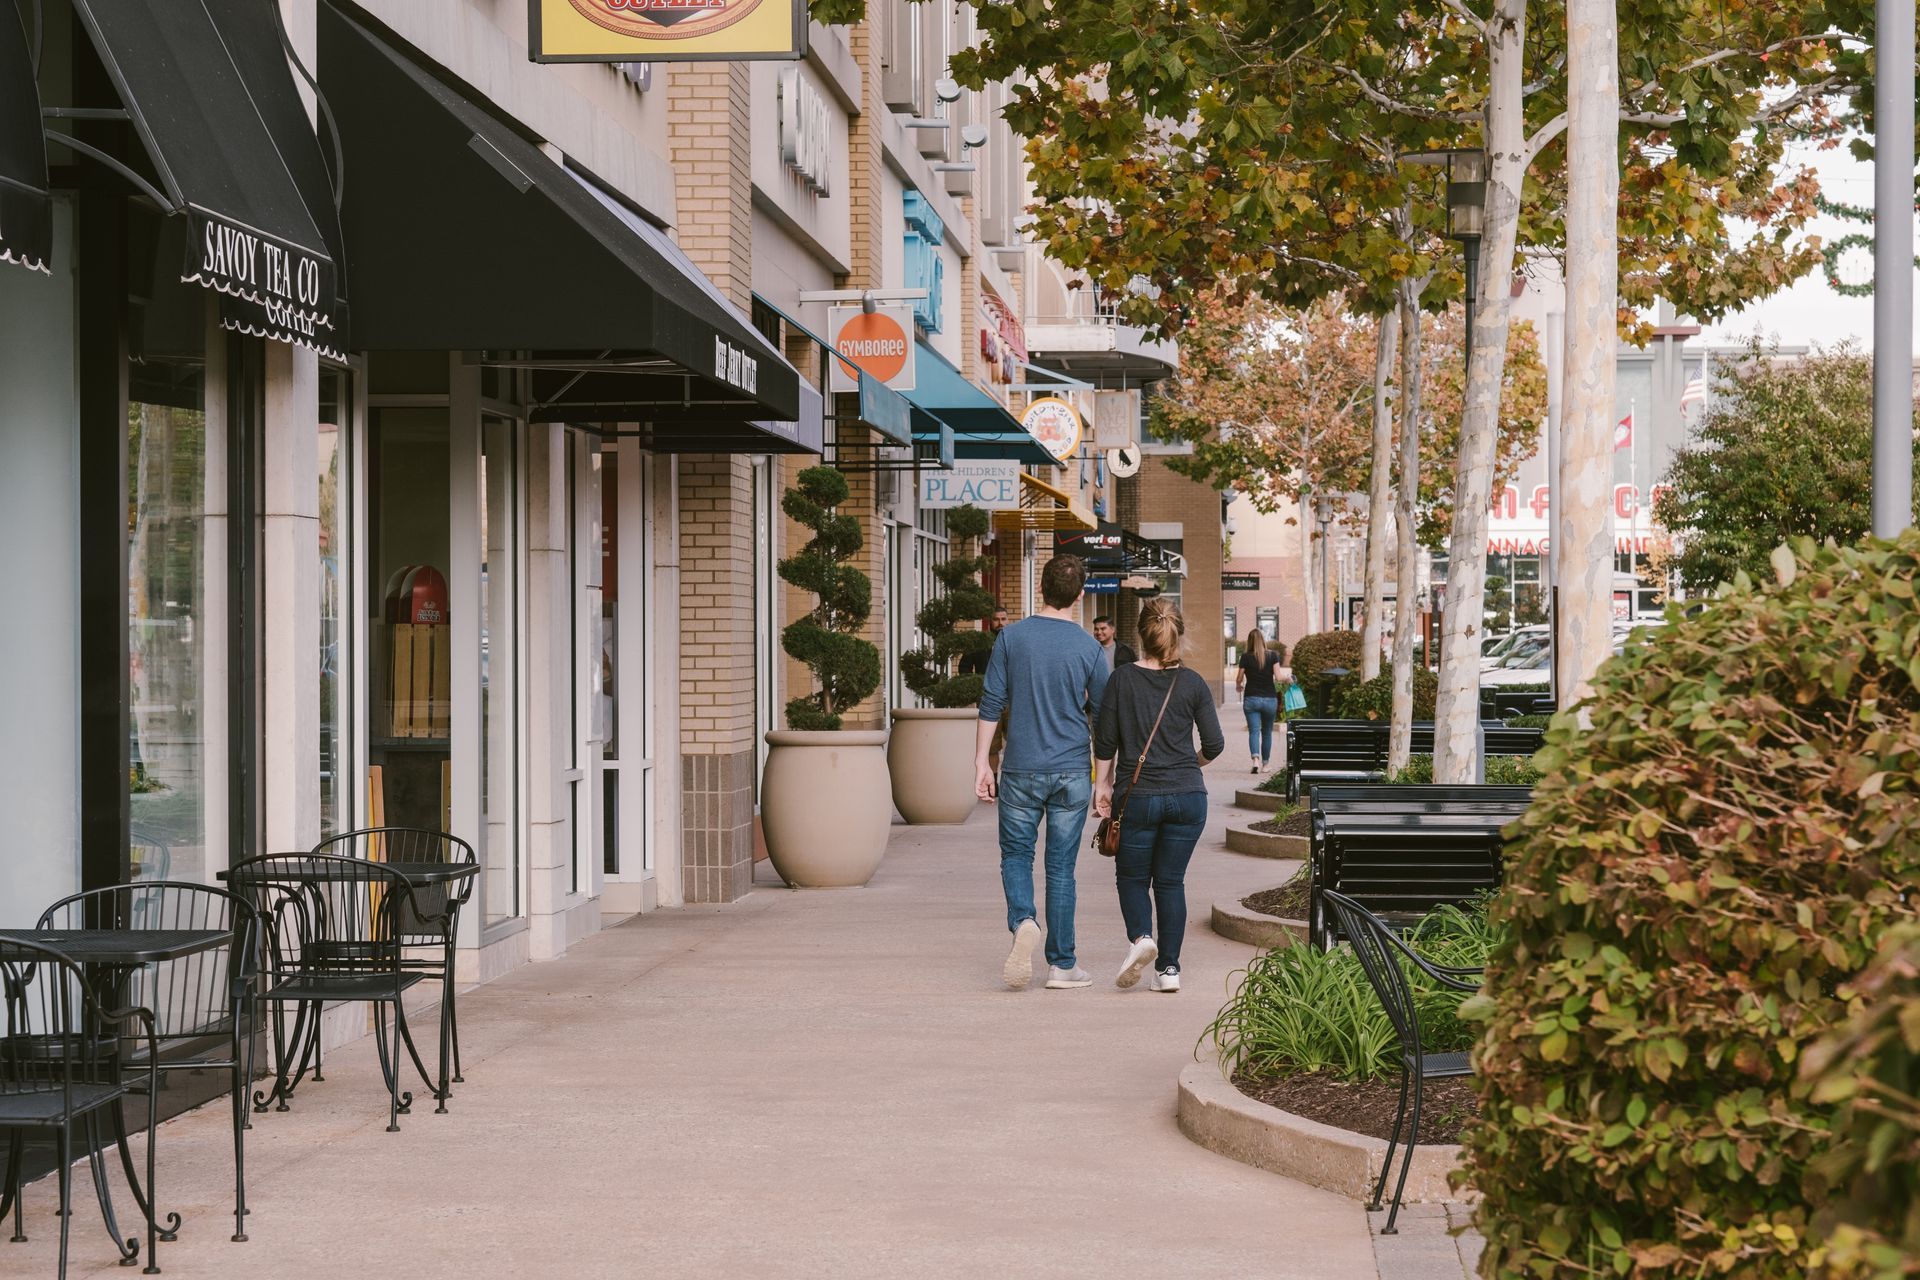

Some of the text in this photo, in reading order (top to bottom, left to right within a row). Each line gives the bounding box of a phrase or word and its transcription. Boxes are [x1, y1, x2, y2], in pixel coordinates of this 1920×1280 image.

[203, 220, 319, 306] SAVOY TEA CO
[950, 467, 1015, 477] CHILDRENS
[925, 478, 1015, 502] PLACE
[1083, 534, 1121, 544] verizon
